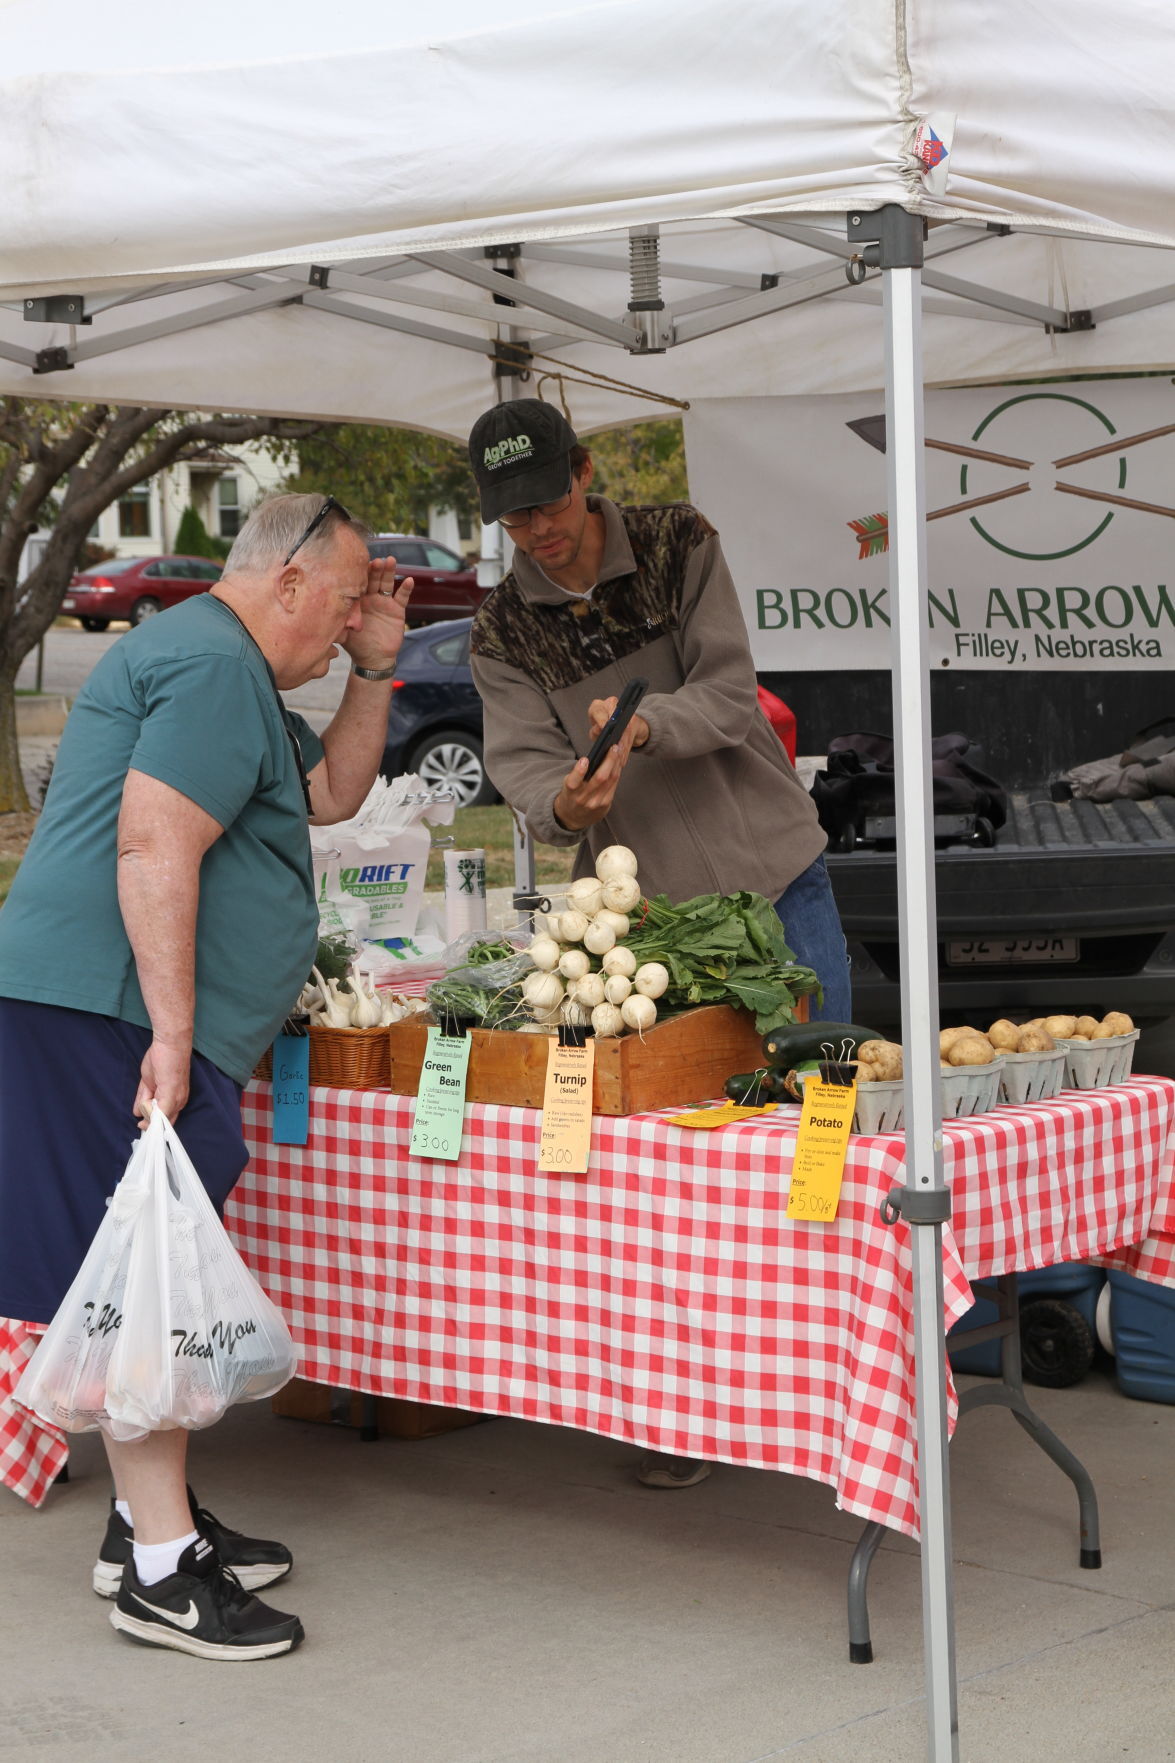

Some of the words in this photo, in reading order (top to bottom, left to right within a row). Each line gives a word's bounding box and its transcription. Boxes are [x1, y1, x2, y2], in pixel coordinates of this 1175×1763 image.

[484, 435, 531, 464] AgPhD
[504, 451, 532, 464] TOGETHER
[756, 588, 961, 630] BROKN
[985, 584, 1175, 630] ARROW
[954, 633, 1027, 663] Filley,
[1035, 633, 1162, 659] Nebraska
[425, 1060, 452, 1072] Green
[439, 1076, 461, 1087] Bean
[553, 1073, 587, 1087] Turnip
[809, 1116, 843, 1129] Potato
[212, 1318, 257, 1355] You
